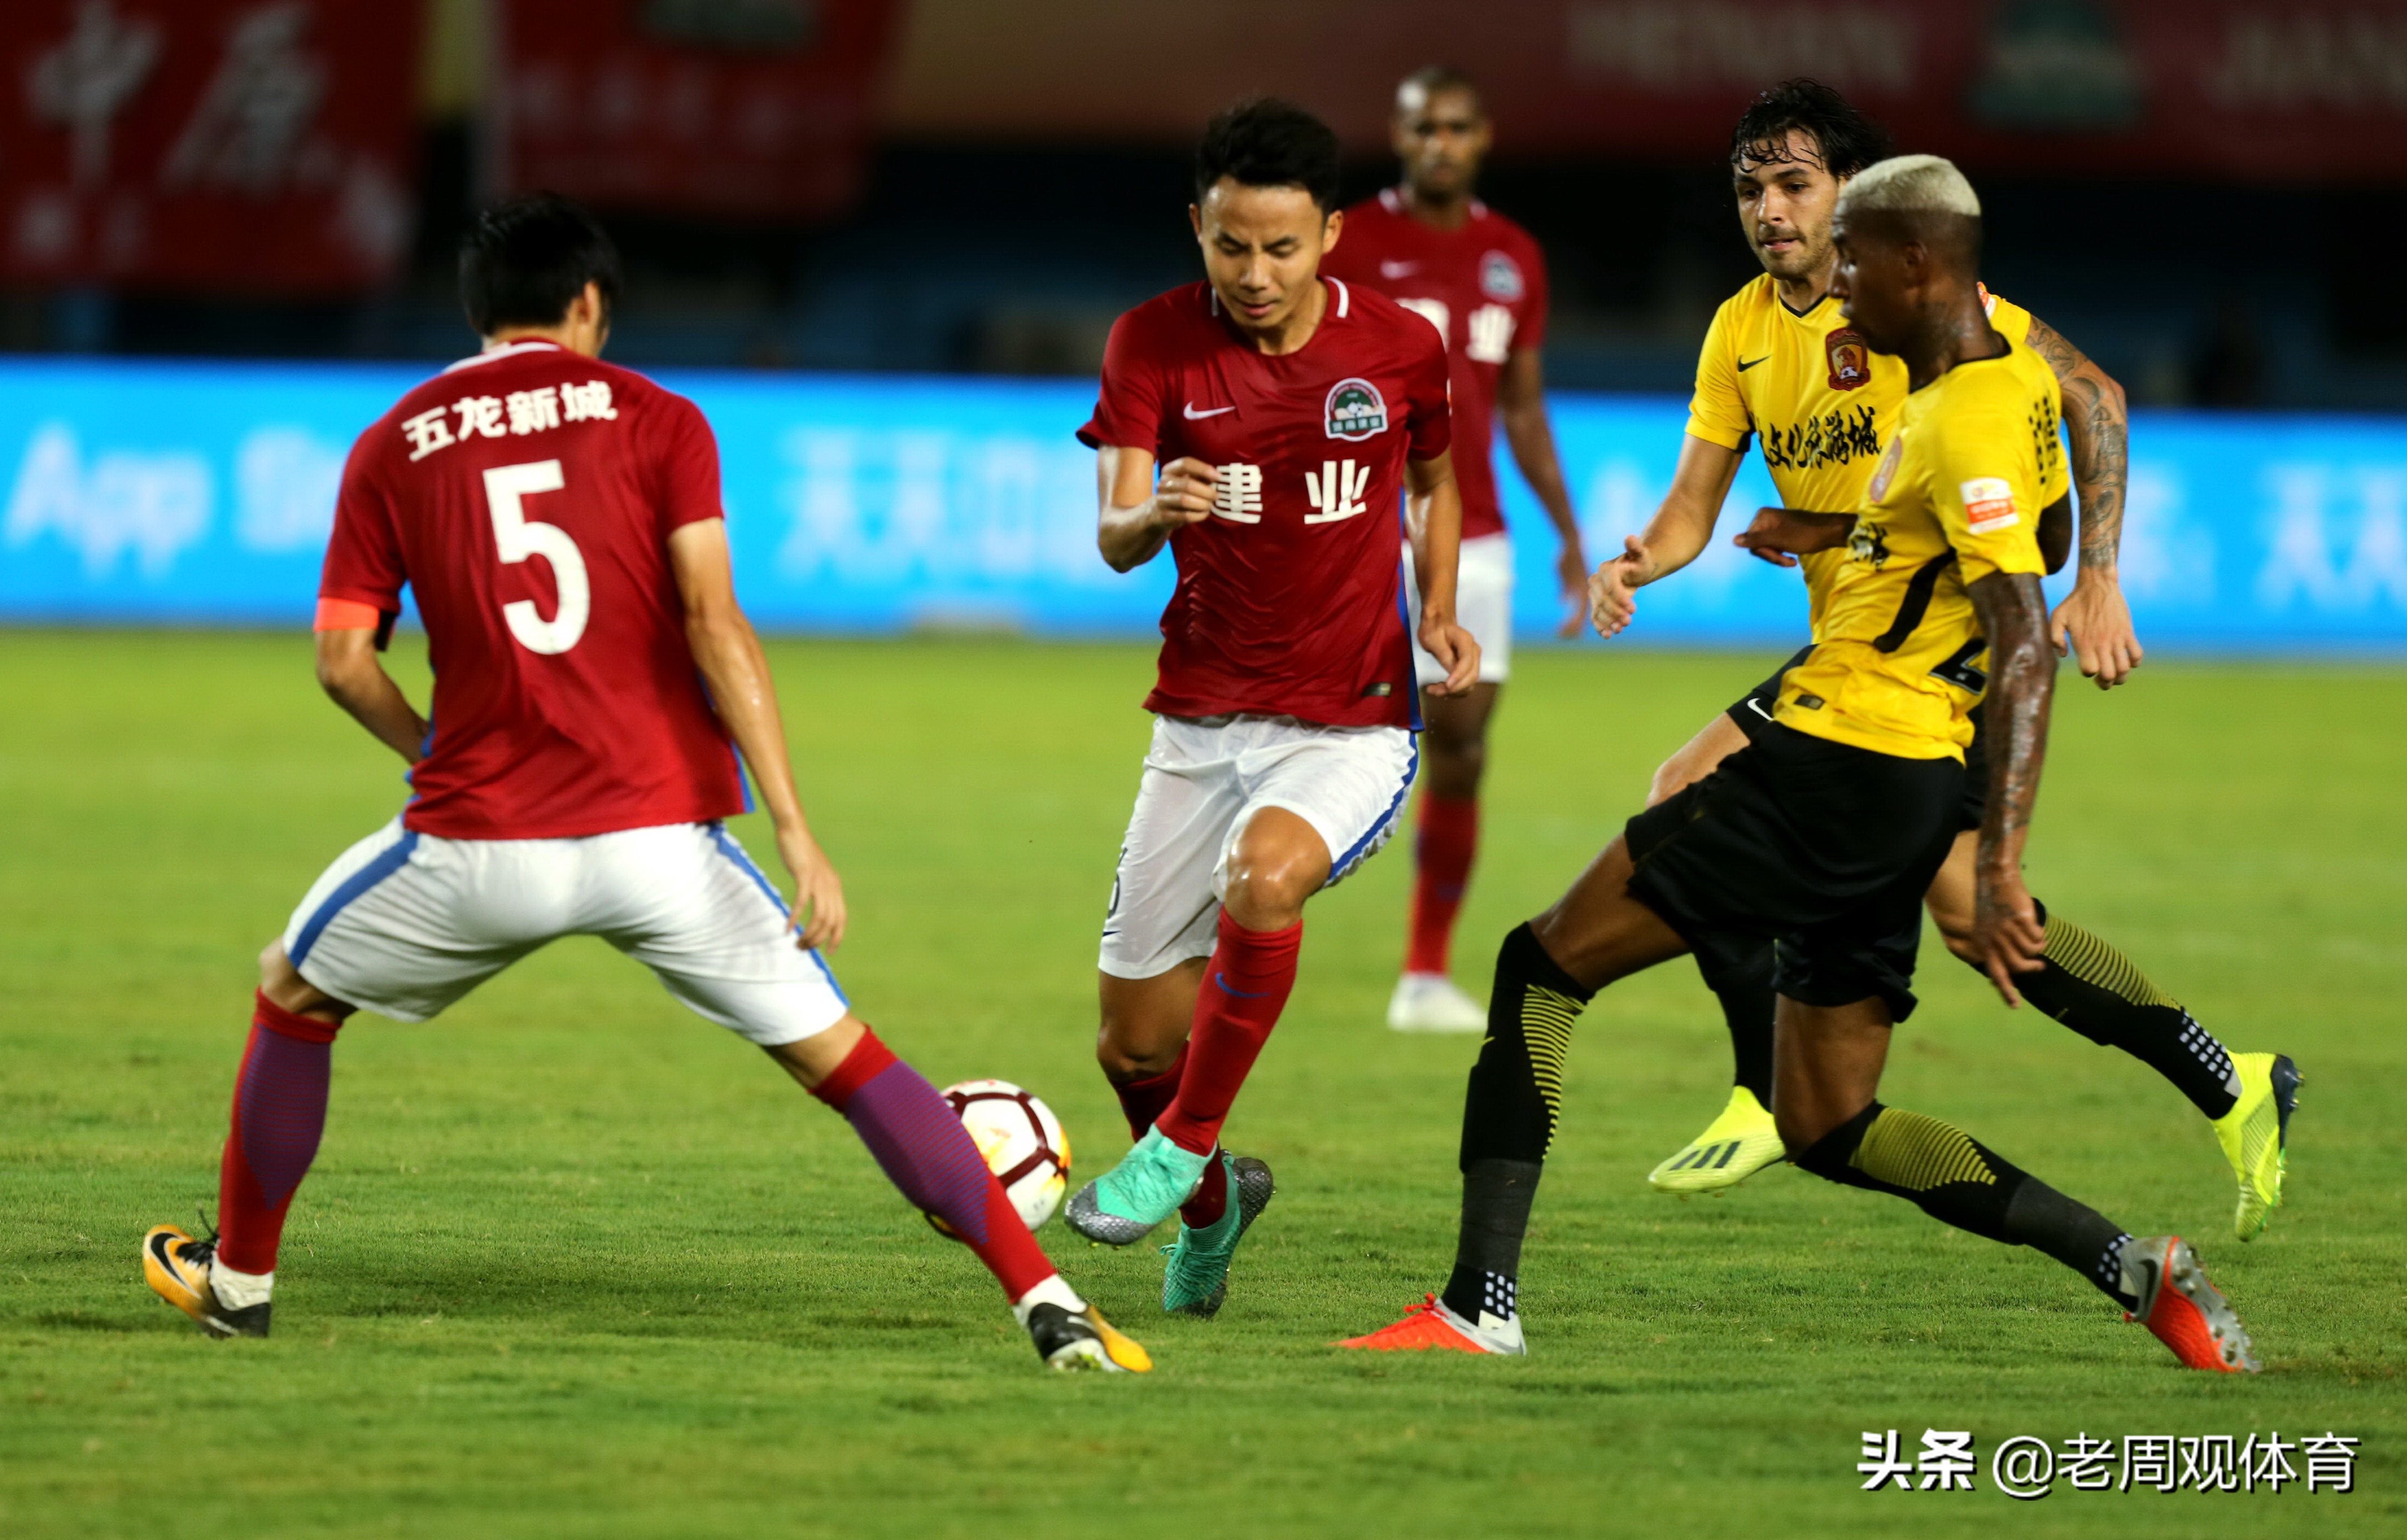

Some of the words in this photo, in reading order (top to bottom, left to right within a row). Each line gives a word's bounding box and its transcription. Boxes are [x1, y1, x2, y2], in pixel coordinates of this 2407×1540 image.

[402, 380, 618, 462] 五龙新城
[1758, 404, 1882, 471] 文化旅游城
[1210, 459, 1370, 524] 建业
[482, 459, 590, 655] 5
